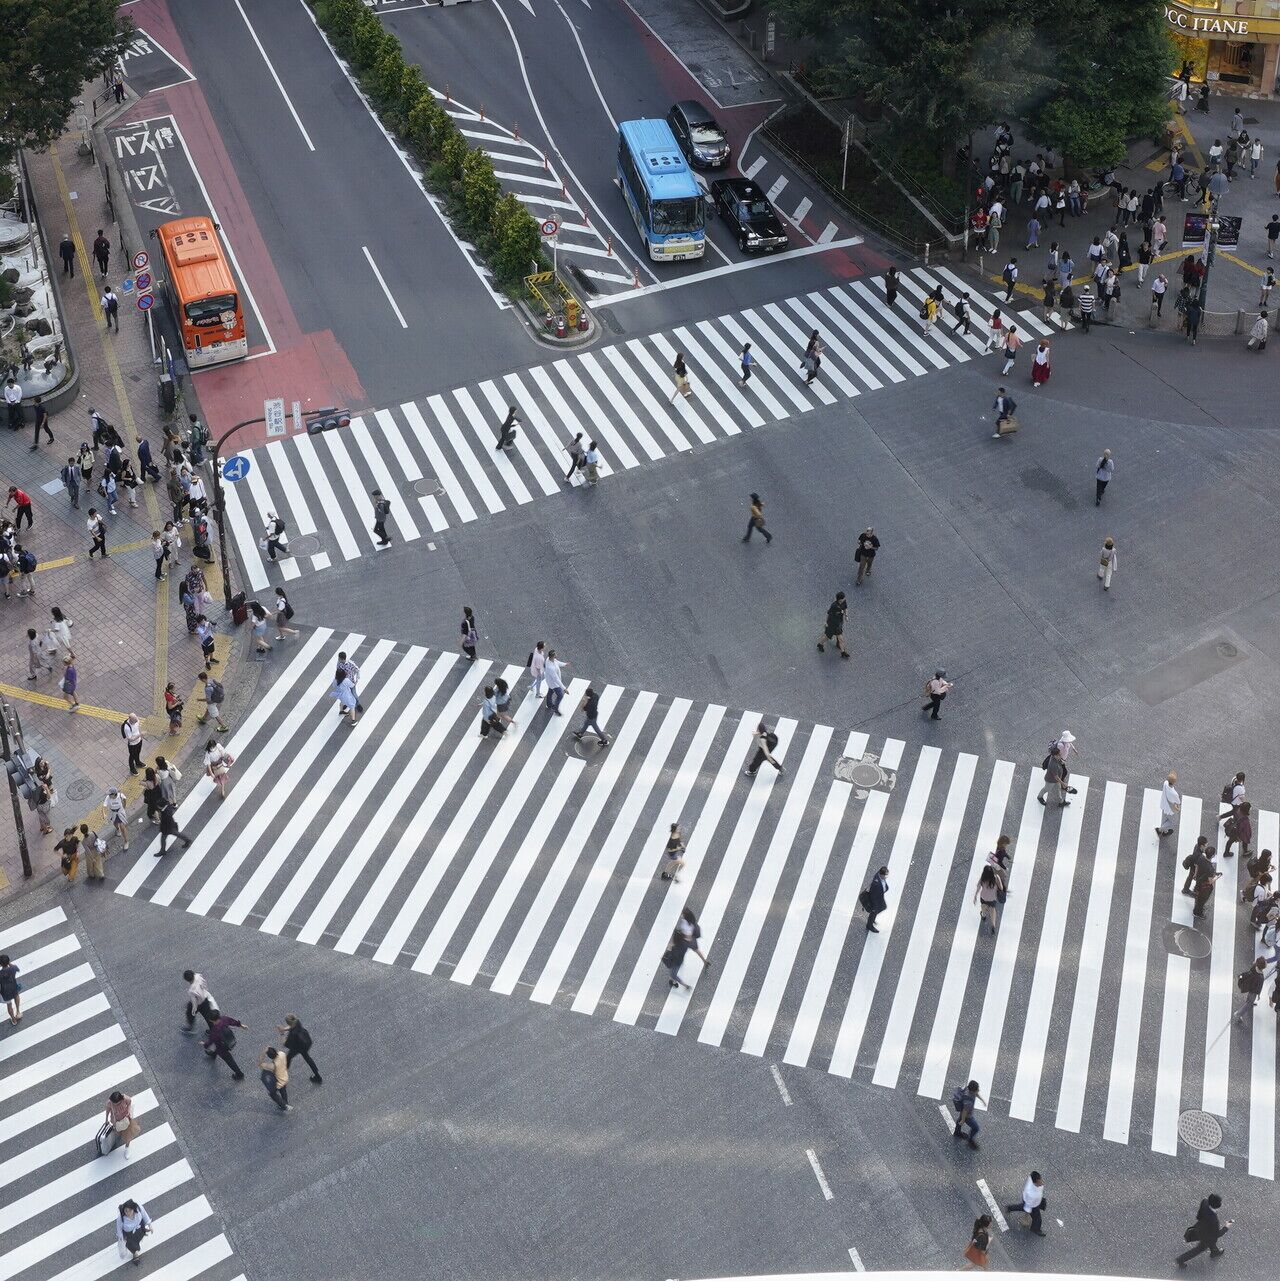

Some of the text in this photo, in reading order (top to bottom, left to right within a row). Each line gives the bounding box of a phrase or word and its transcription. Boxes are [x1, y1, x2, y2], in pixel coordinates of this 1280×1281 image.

[115, 126, 175, 158] バス停
[124, 164, 165, 192] バス
